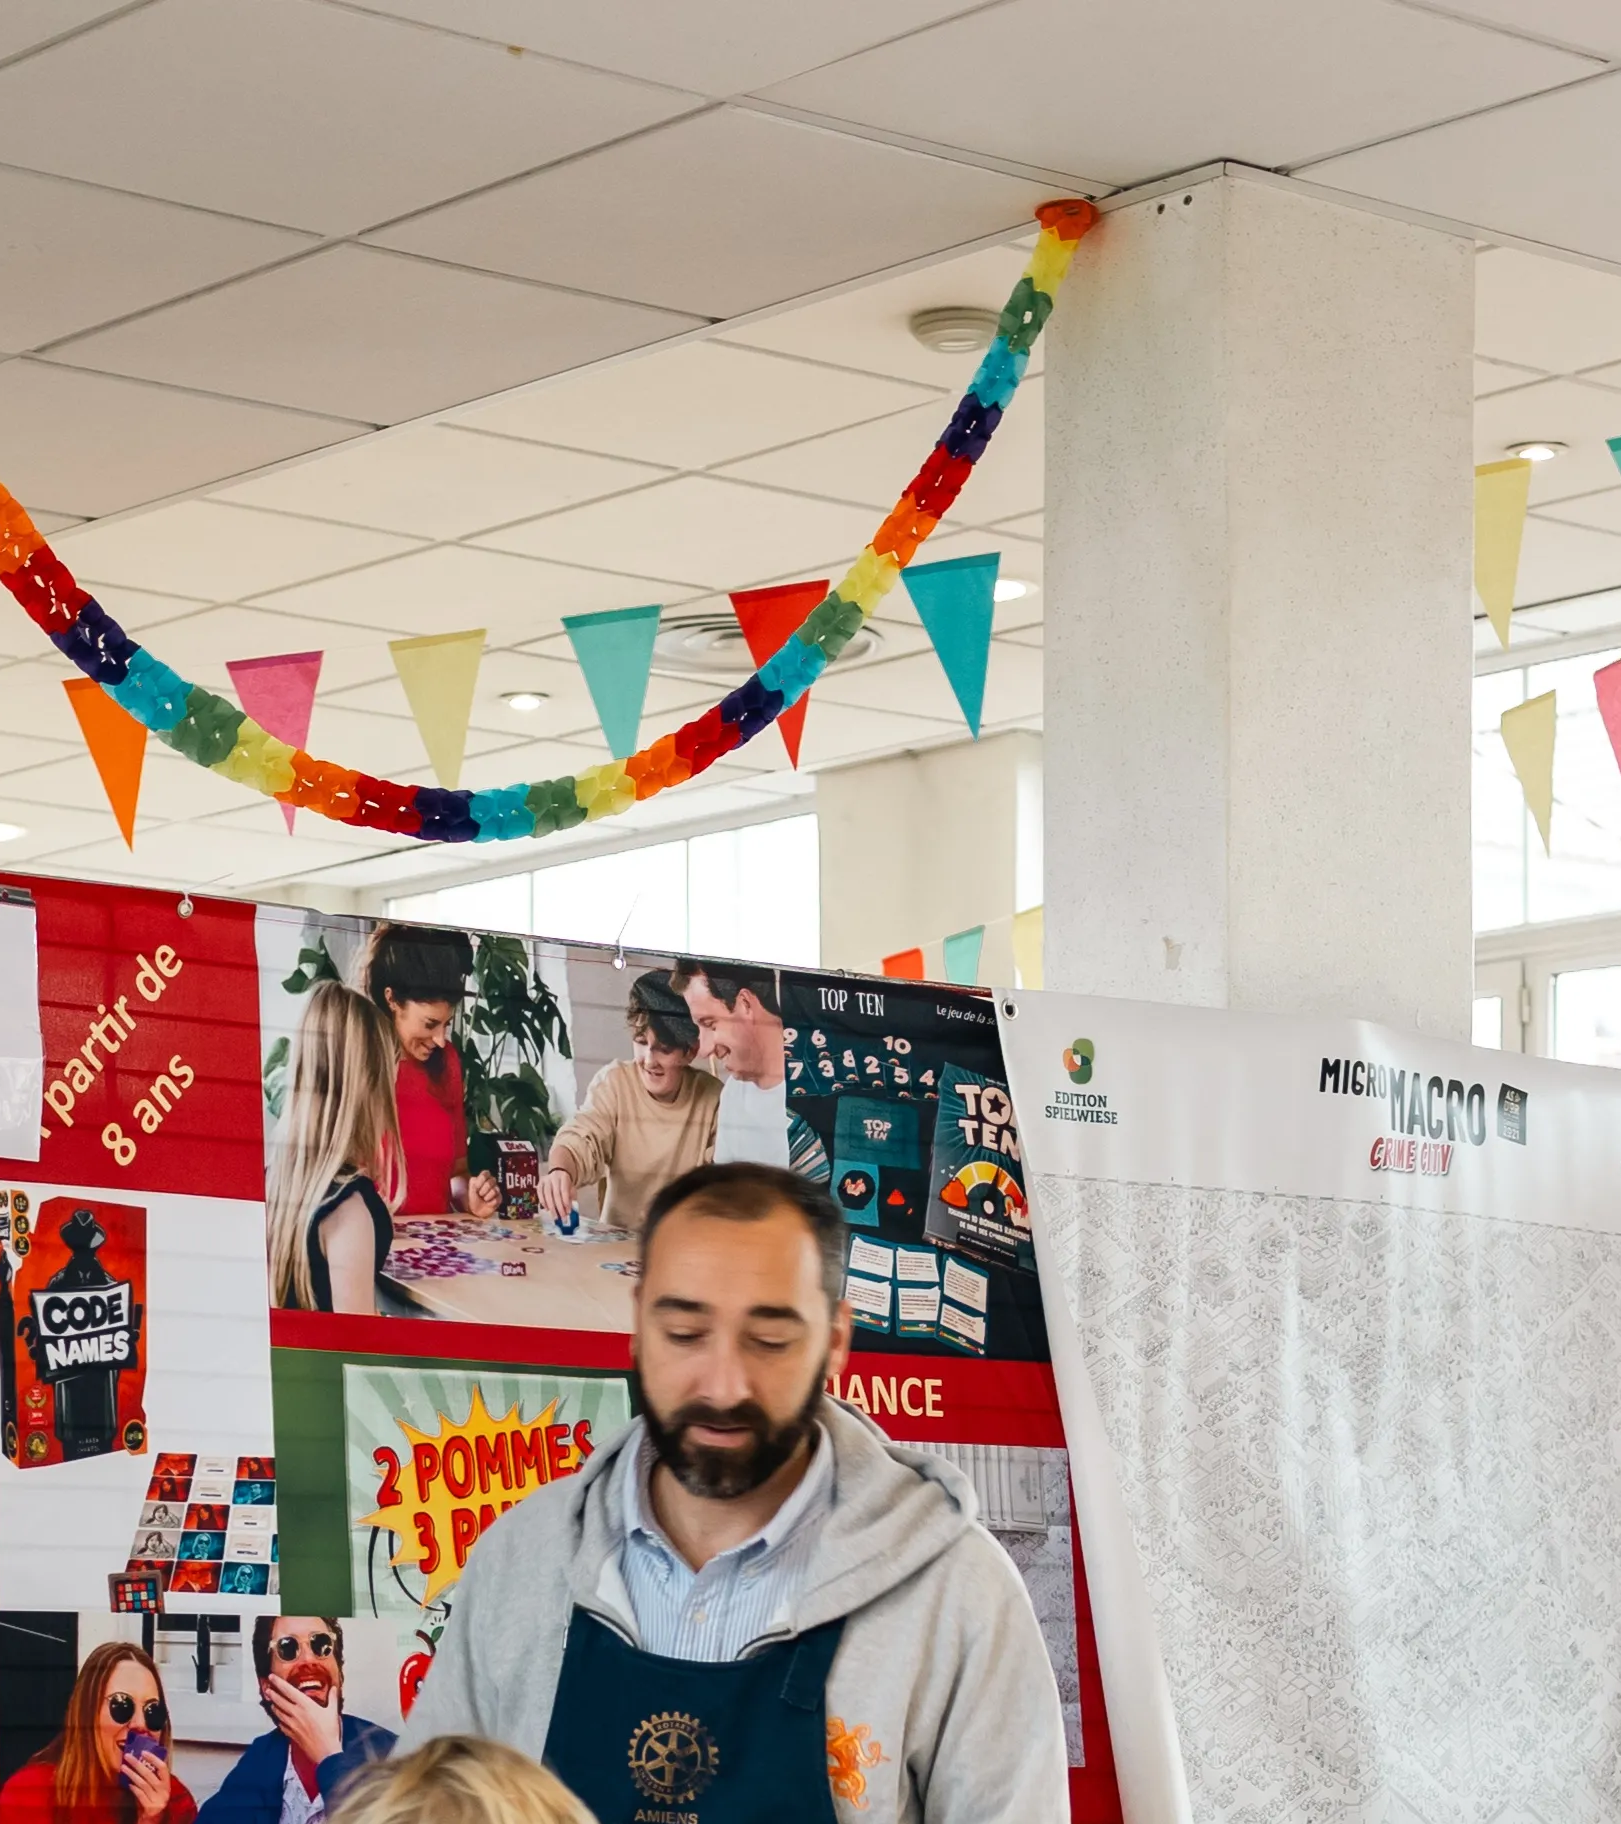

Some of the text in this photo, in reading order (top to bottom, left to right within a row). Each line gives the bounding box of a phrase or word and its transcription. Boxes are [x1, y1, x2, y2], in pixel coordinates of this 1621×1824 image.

[817, 987, 884, 1017] TOP TEN
[936, 1004, 947, 1016] Le
[947, 1007, 962, 1022] jeu
[963, 1011, 975, 1022] de
[43, 944, 184, 1128] partir de
[883, 1035, 911, 1055] 10
[787, 1049, 935, 1086] 7 3 8 2 5 4
[101, 1054, 196, 1167] 8 ans
[1044, 1107, 1119, 1125] SPIELWIESE
[1054, 1090, 1109, 1109] EDITION
[863, 1119, 892, 1132] TOP
[865, 1129, 888, 1141] TEN
[958, 1119, 1021, 1163] TEN
[1369, 1136, 1453, 1176] CRIME CITY
[506, 1171, 538, 1190] DÉKAL
[42, 1293, 124, 1336] CODE
[45, 1330, 131, 1372] NAMES
[831, 1373, 944, 1418] IANCE
[373, 1419, 596, 1507] 2 POMMES
[413, 1511, 441, 1575] 3
